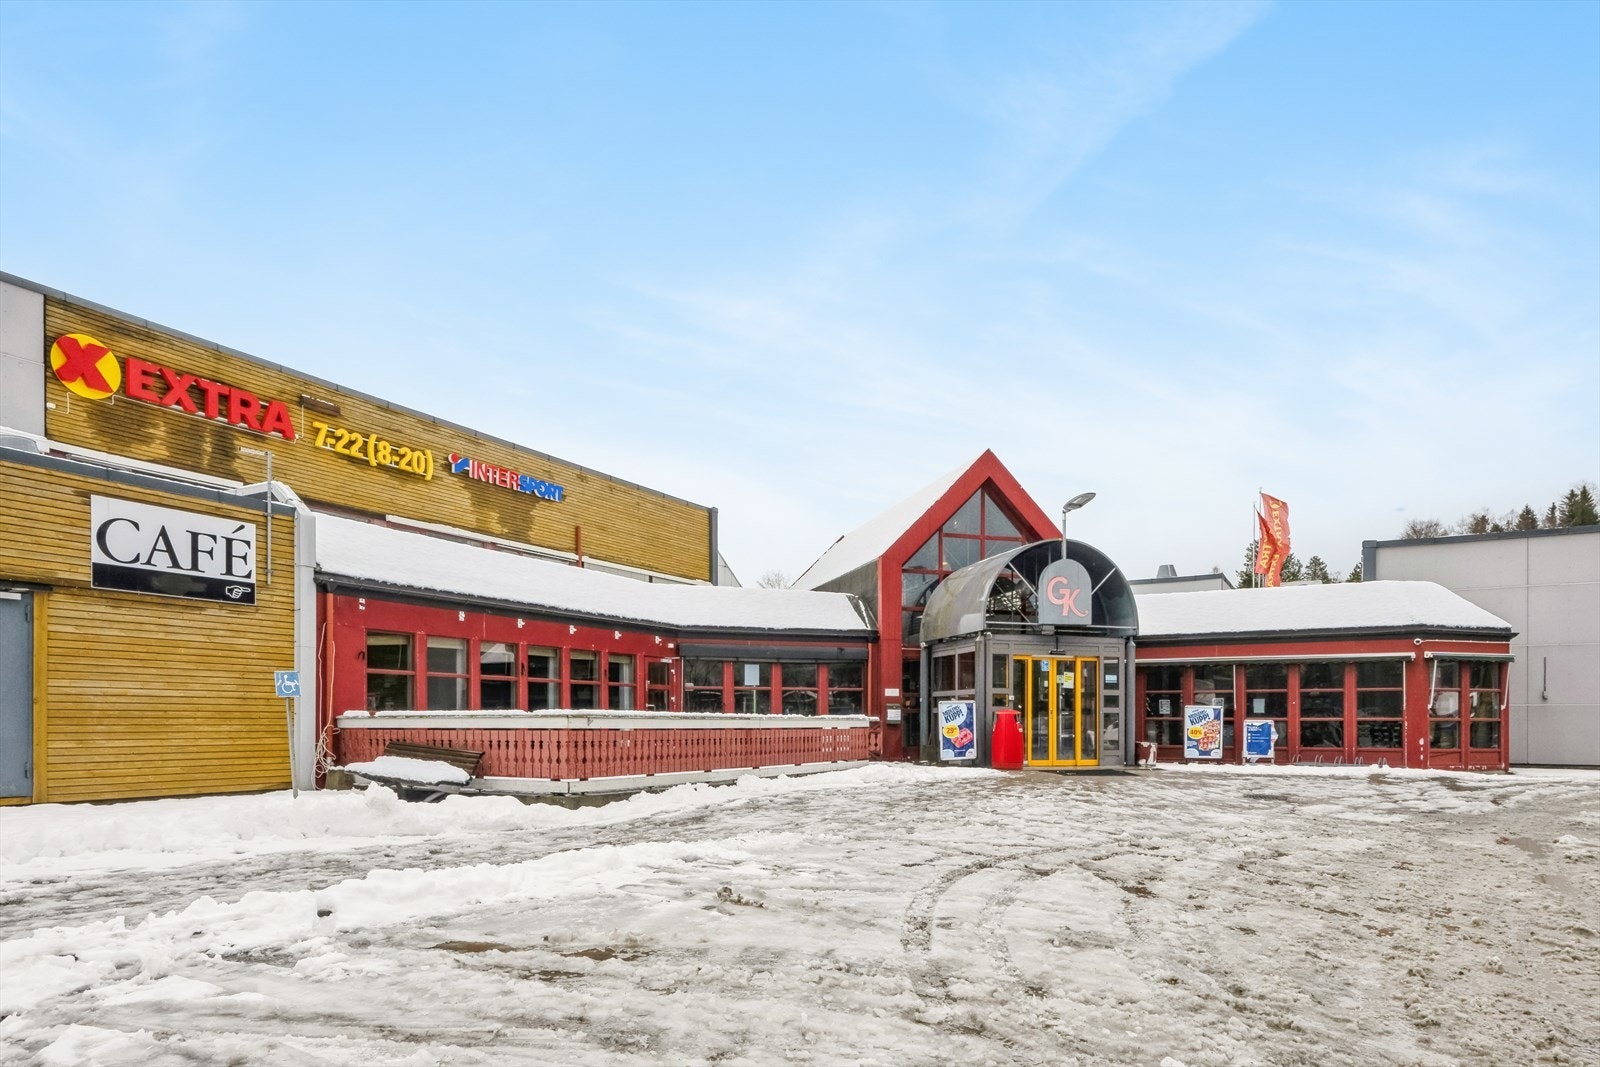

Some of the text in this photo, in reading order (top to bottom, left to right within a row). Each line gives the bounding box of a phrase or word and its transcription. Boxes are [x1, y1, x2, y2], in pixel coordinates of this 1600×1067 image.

[125, 357, 297, 440] EXTRA
[312, 421, 434, 481] 7-22 (8-20)
[468, 460, 564, 502] INTERSPORT
[96, 517, 253, 579] CAFÉ
[1047, 575, 1089, 617] GK
[944, 709, 965, 724] KUPP!
[1189, 713, 1211, 726] KUPP!
